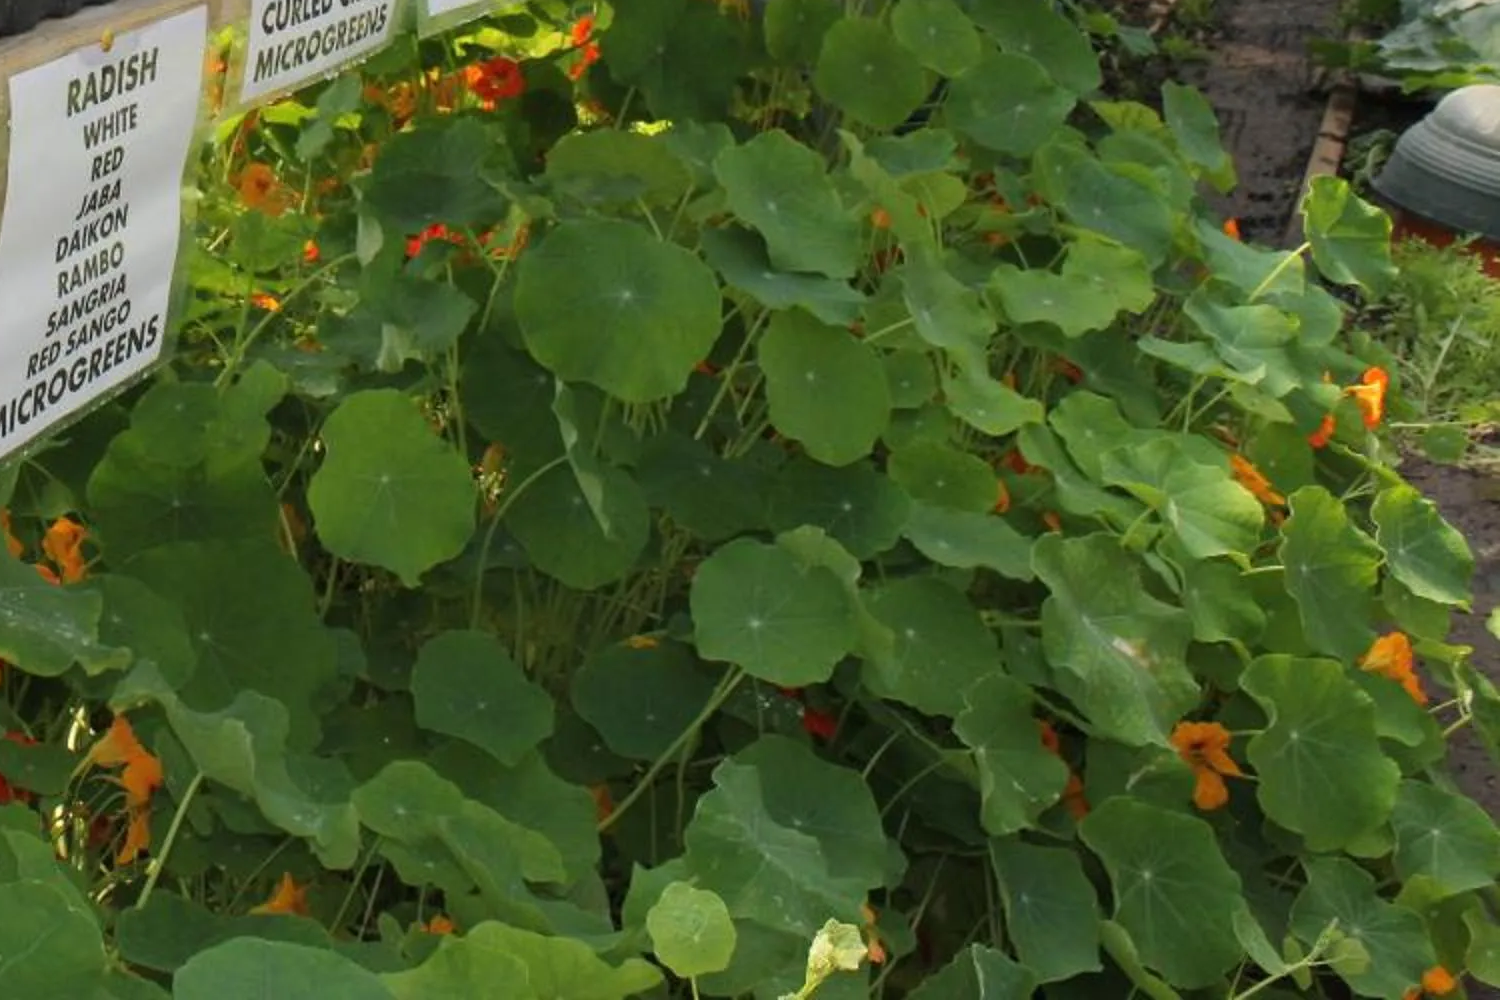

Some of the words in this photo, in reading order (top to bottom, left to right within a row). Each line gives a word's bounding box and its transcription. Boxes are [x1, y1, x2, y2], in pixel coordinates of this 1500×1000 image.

[253, 4, 388, 83] MICROGREENS
[66, 47, 159, 119] RADISH
[82, 103, 138, 150] WHITE
[90, 145, 125, 183] RED
[75, 178, 122, 222] JABA
[55, 203, 129, 263] DAIKON
[56, 241, 125, 299] RAMBO
[45, 273, 127, 338] SANGRIA
[26, 341, 61, 381] RED
[64, 299, 131, 357] SANGO
